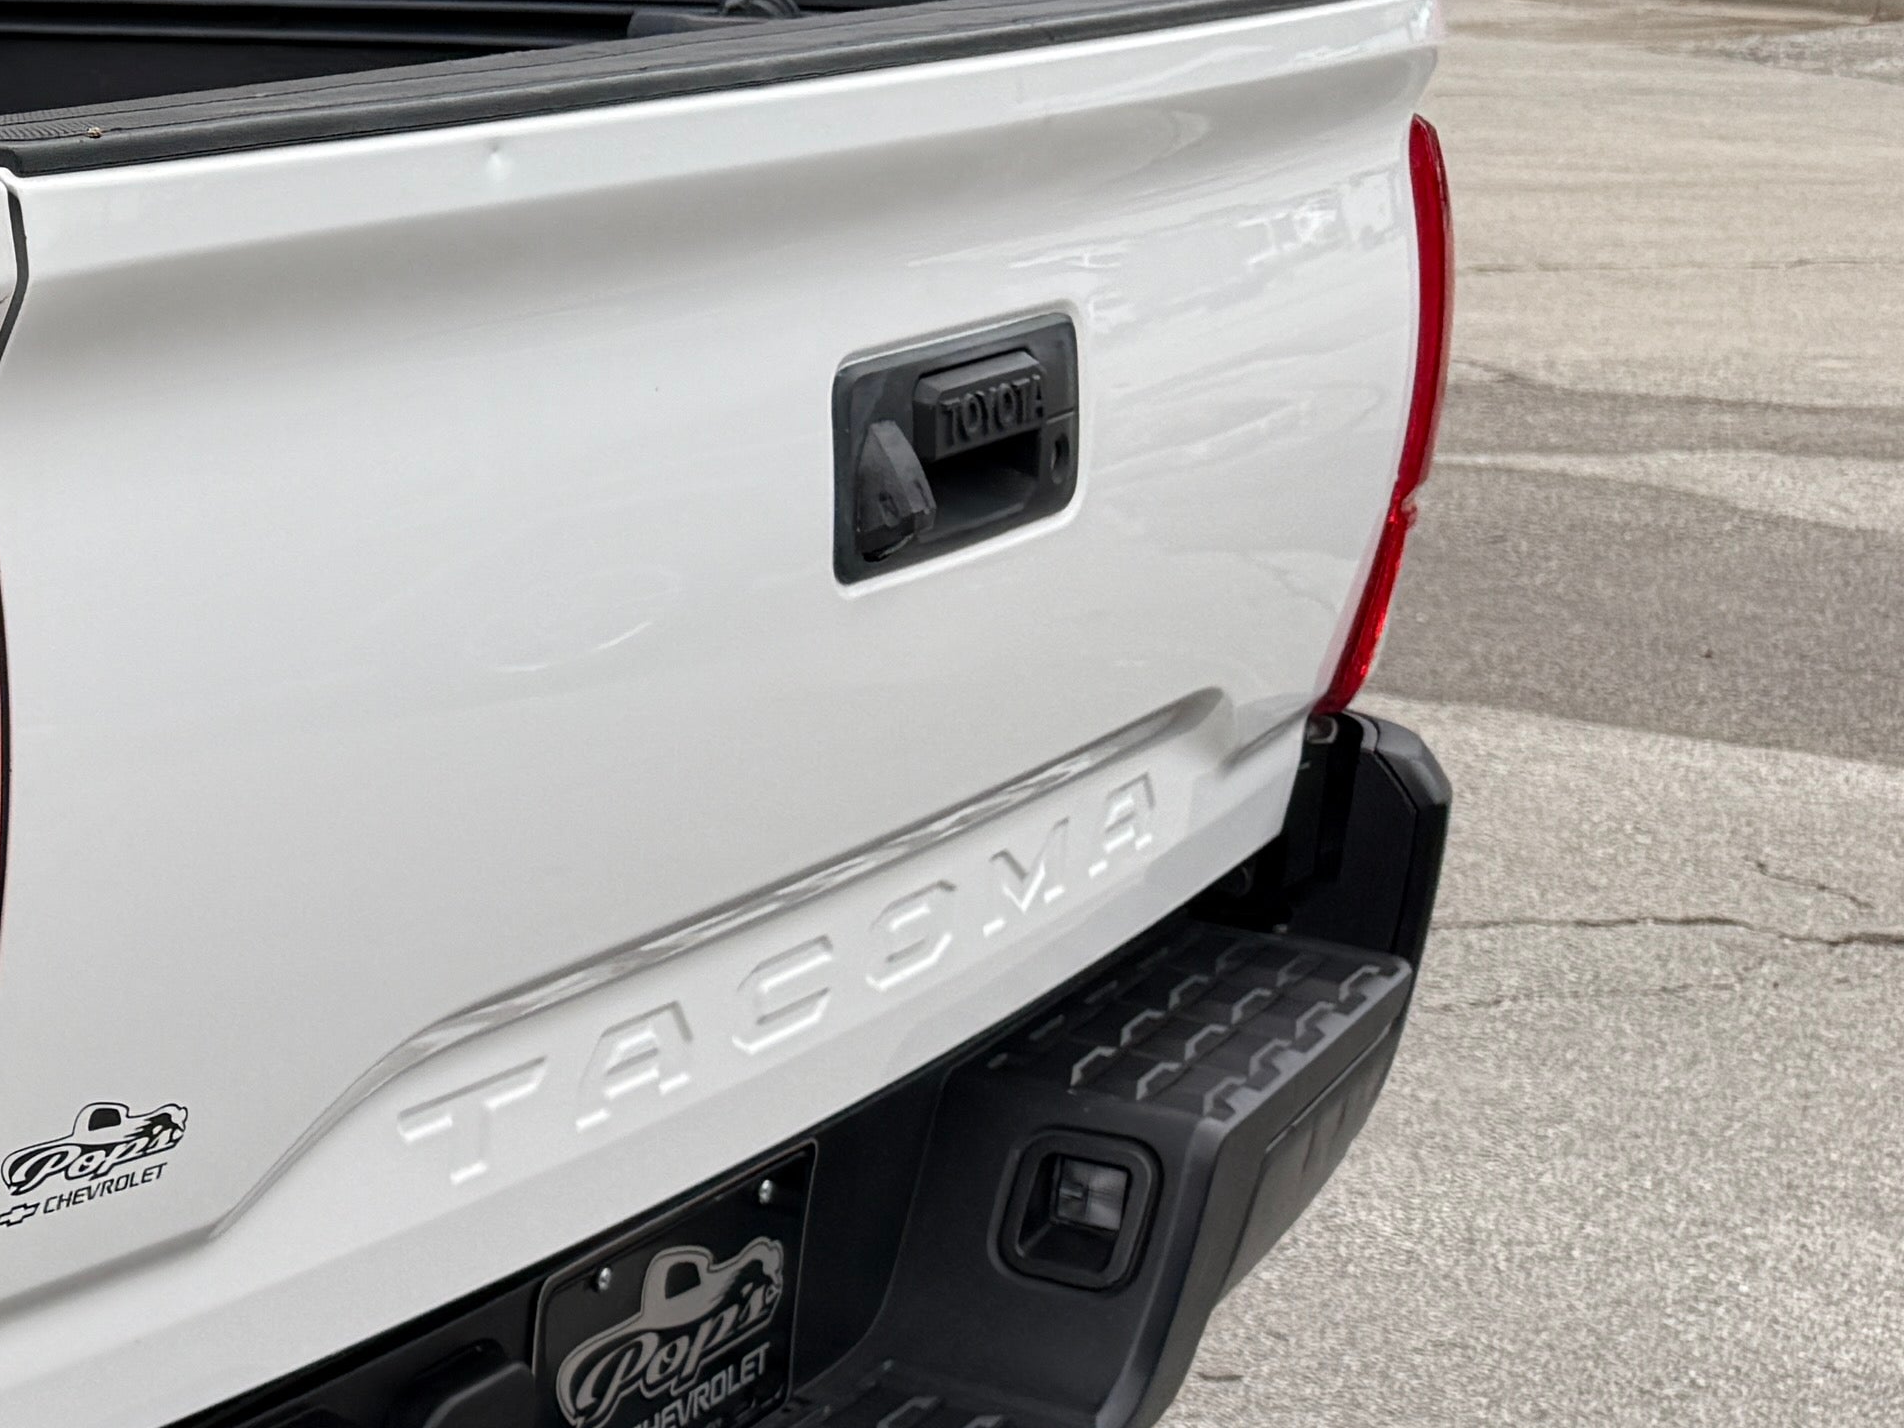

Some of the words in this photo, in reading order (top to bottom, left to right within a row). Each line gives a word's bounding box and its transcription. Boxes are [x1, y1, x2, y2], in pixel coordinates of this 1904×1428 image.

[940, 373, 1046, 450] TOYOTA
[396, 771, 1156, 1186] TACOMA
[42, 1162, 168, 1215] CHEVROLET
